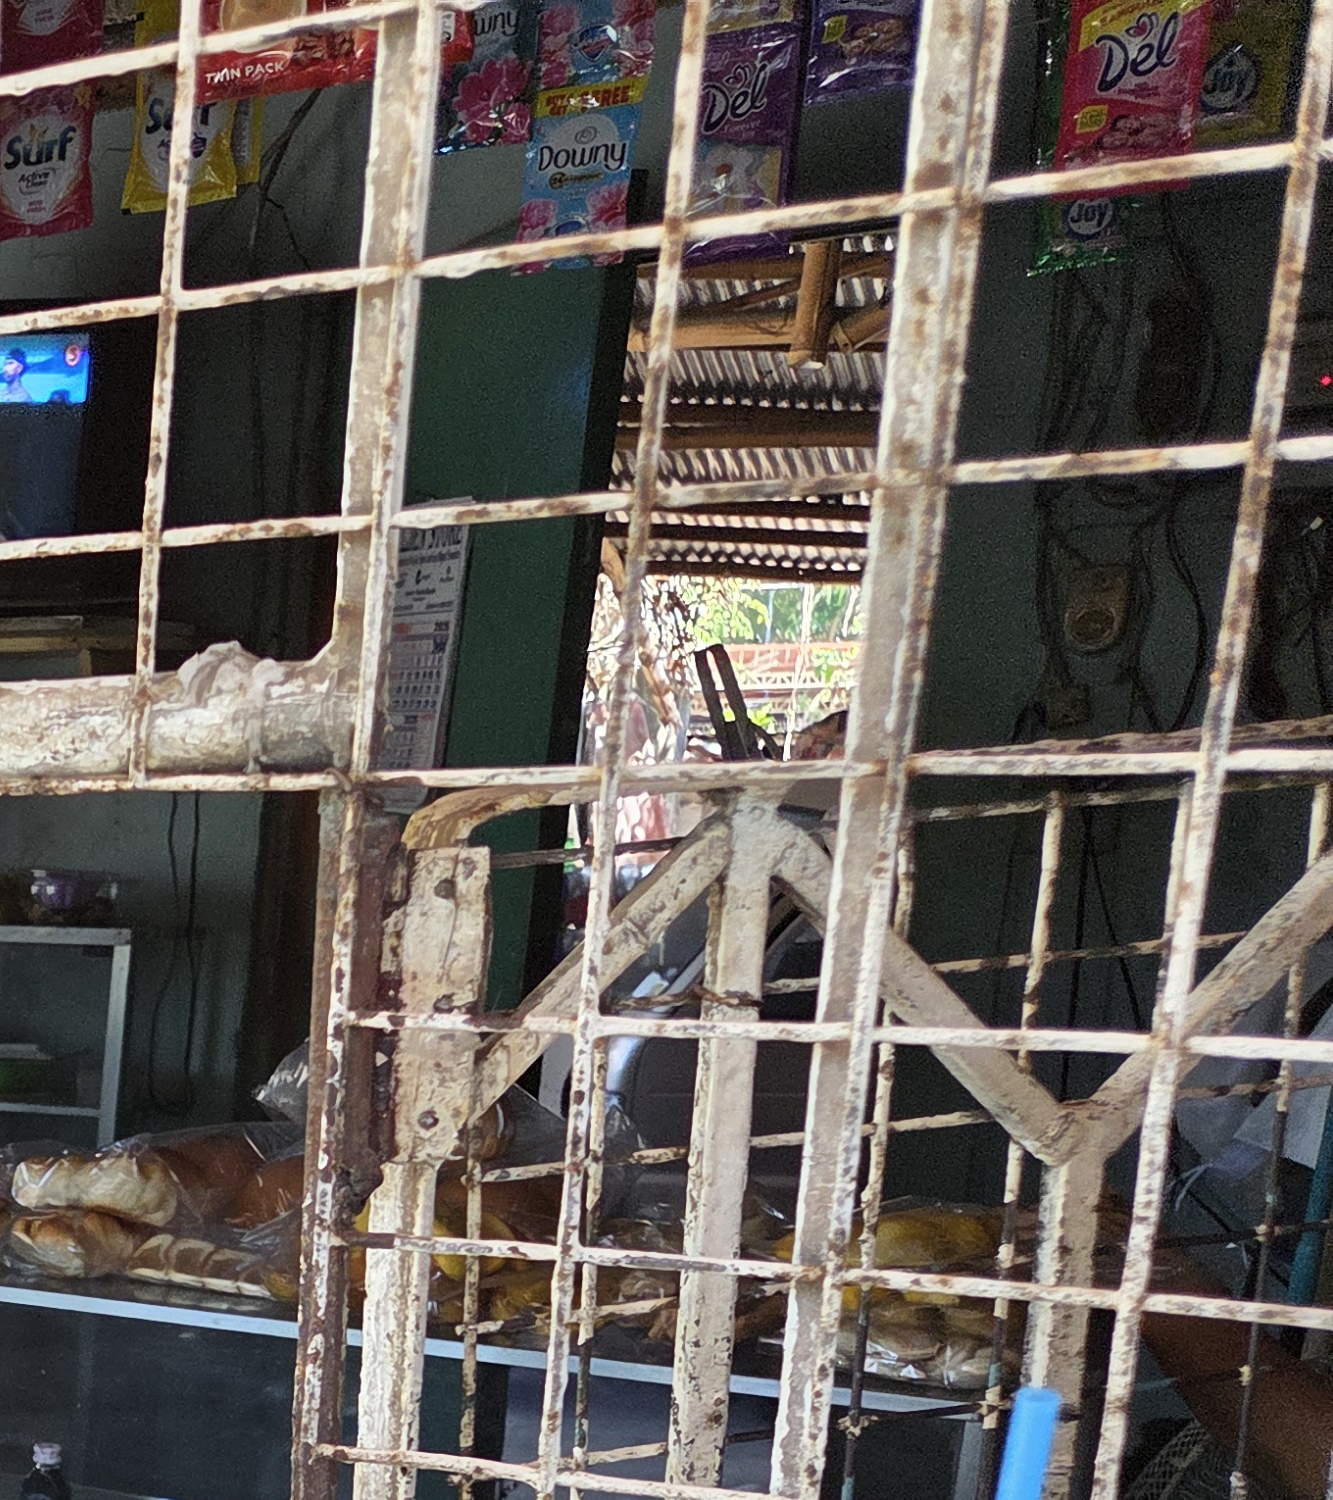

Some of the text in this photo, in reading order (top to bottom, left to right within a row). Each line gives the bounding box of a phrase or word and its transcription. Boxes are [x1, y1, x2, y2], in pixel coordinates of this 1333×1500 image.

[474, 11, 520, 38] wny
[1095, 12, 1180, 92] Del
[205, 61, 286, 85] TWIN PACK
[4, 126, 77, 170] Surf
[538, 142, 628, 172] Downy
